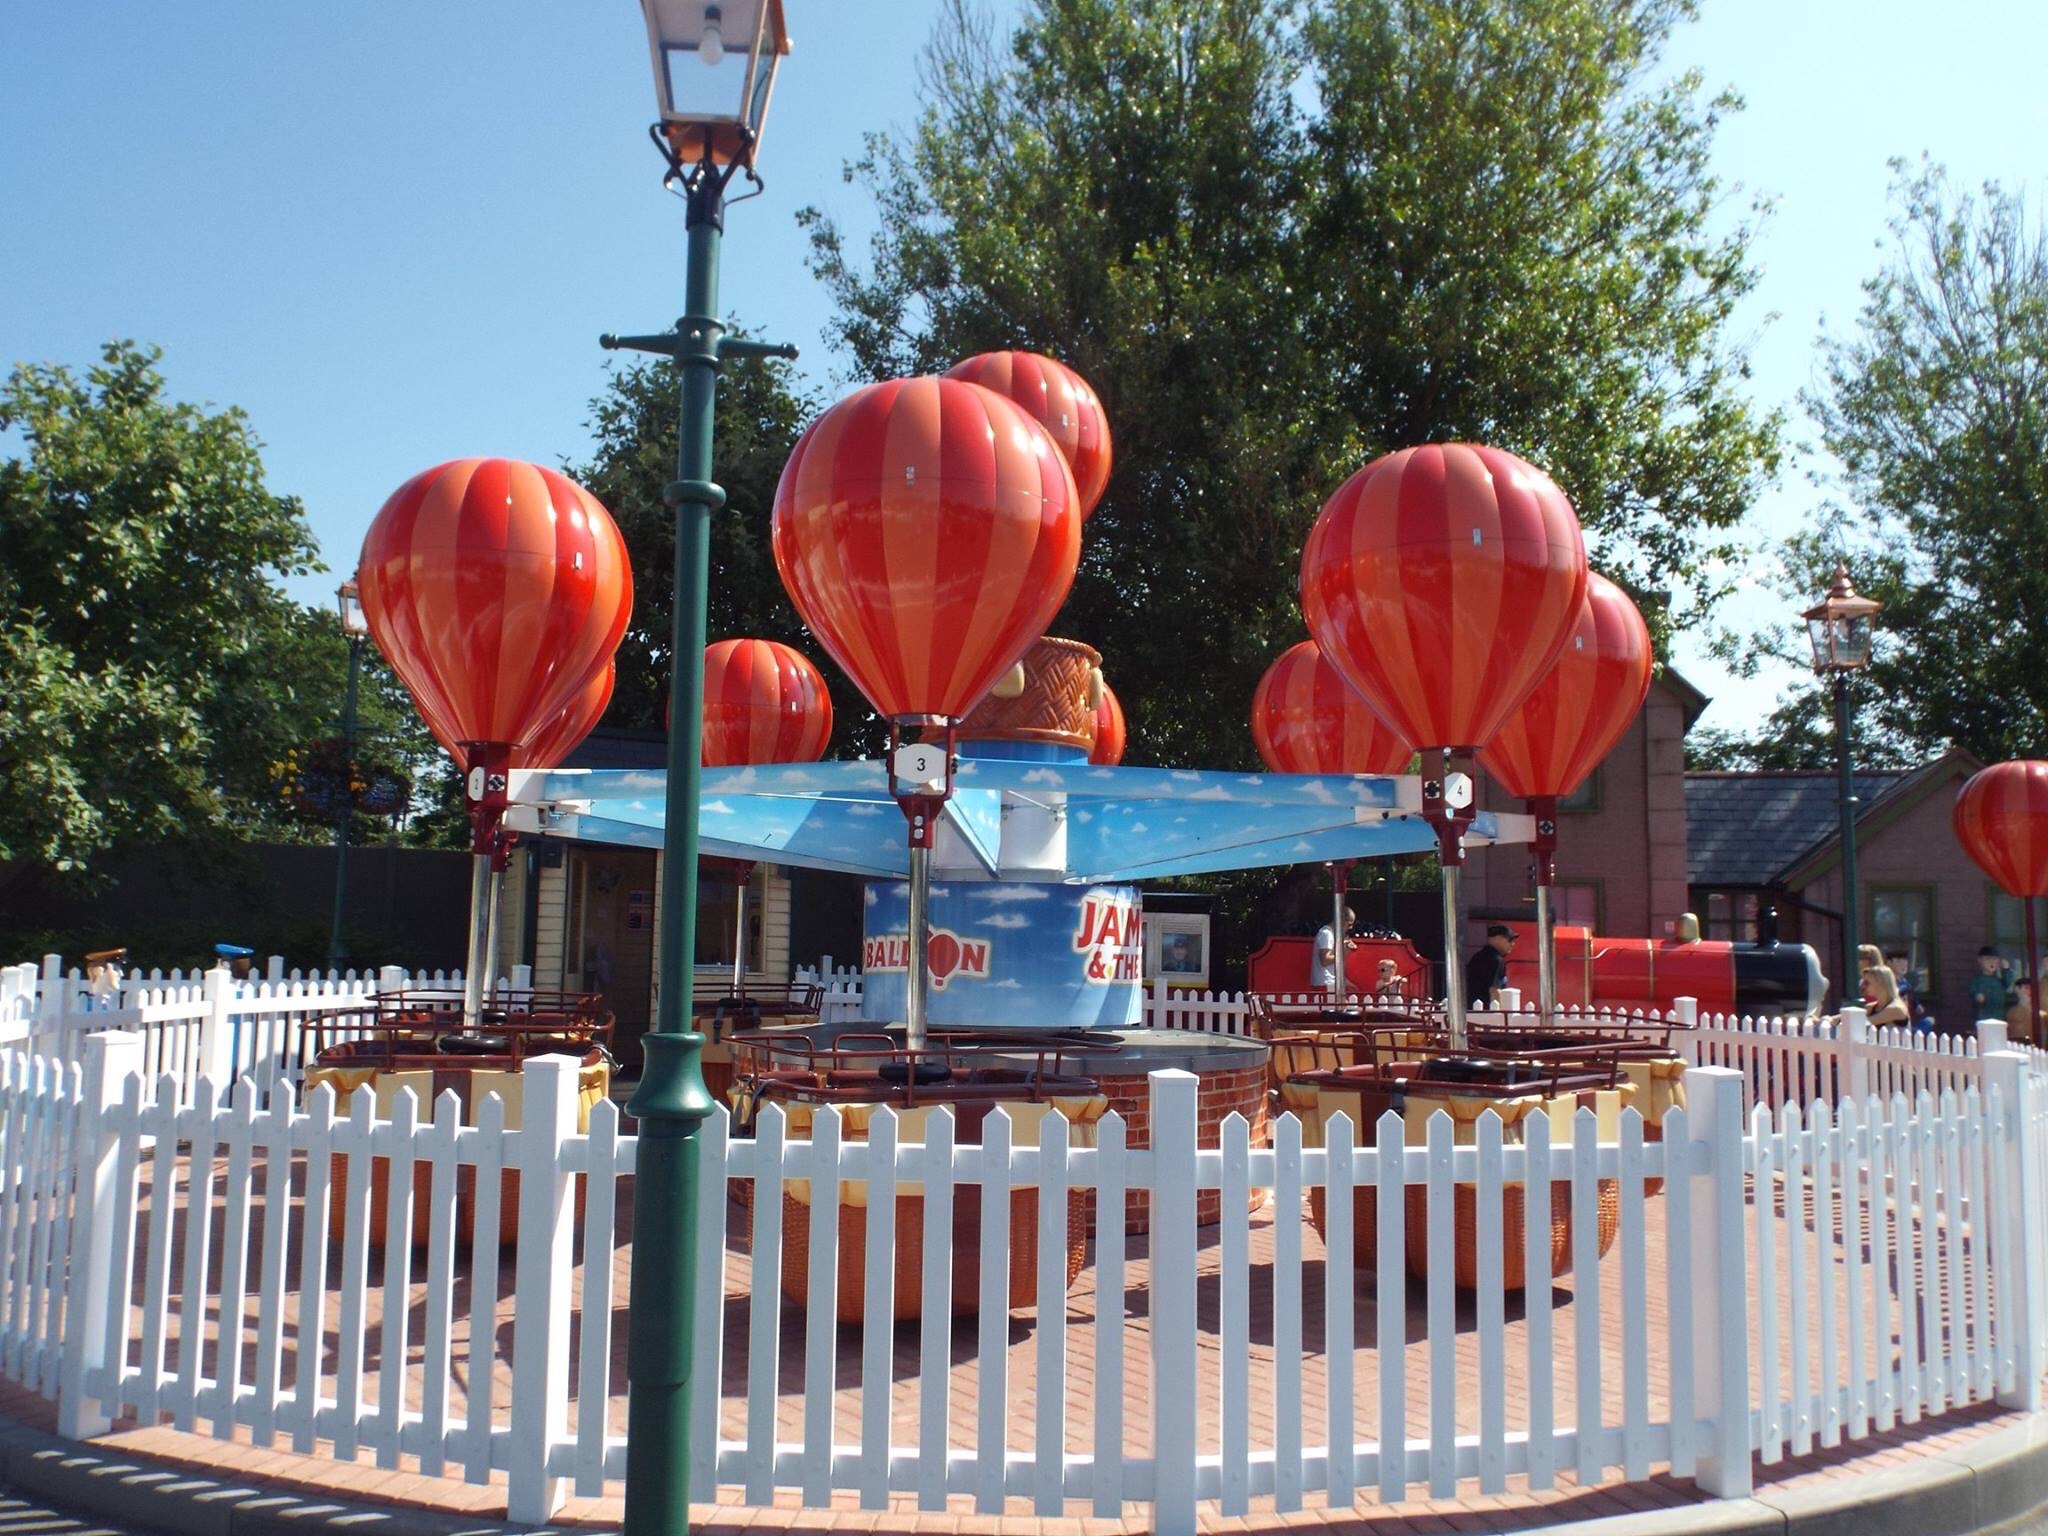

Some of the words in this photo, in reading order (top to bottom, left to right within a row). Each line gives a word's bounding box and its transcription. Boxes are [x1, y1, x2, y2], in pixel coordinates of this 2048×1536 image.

[916, 757, 926, 772] 3
[1456, 785, 1463, 796] 4
[1088, 951, 1106, 979] &
[1112, 953, 1139, 979] THE
